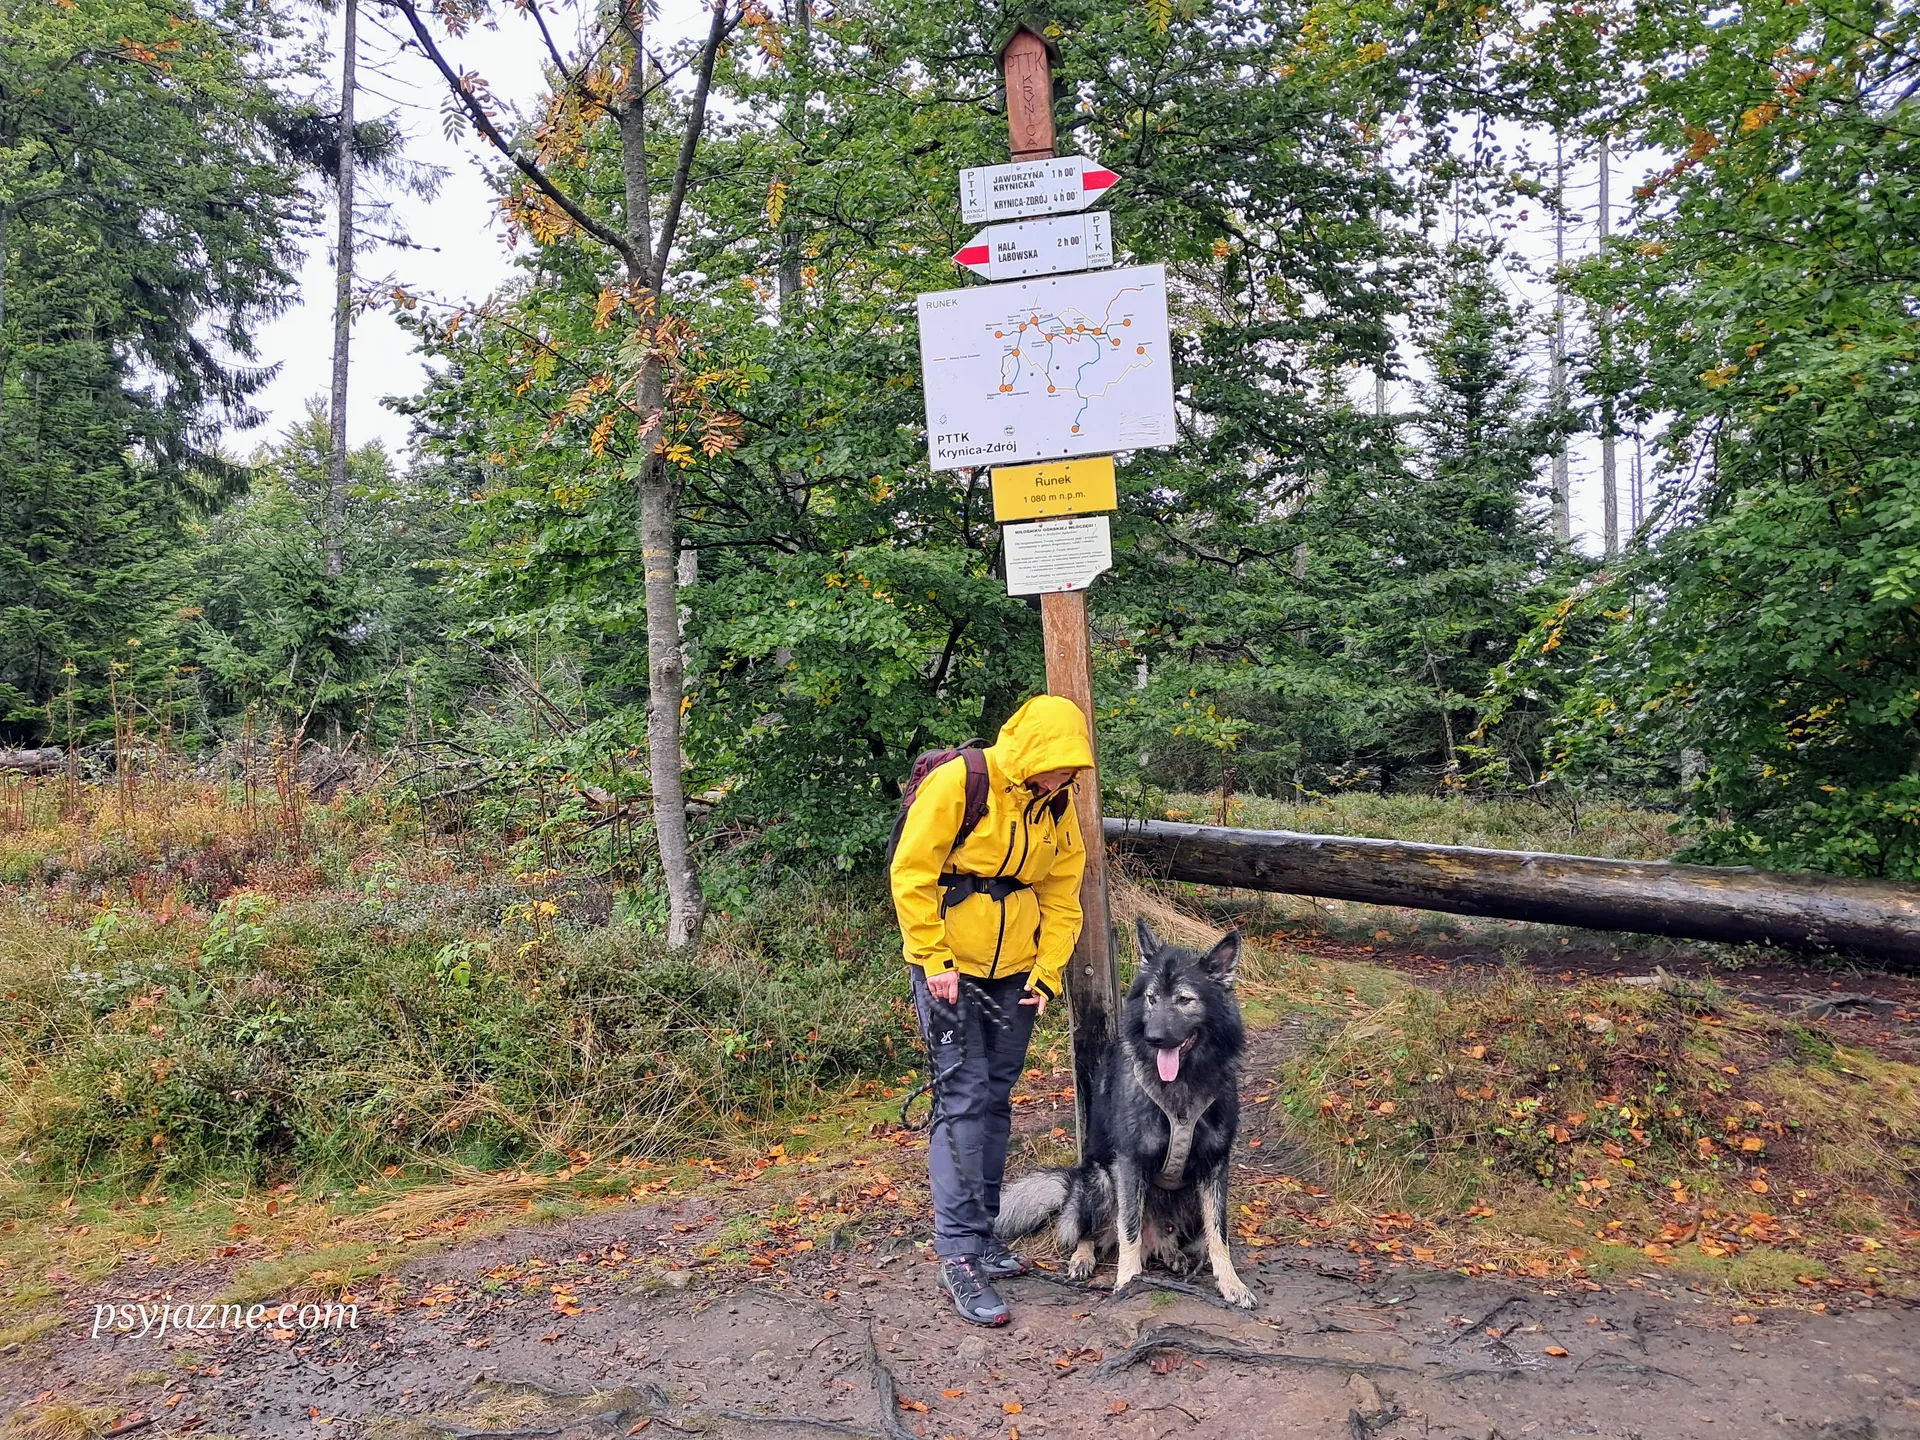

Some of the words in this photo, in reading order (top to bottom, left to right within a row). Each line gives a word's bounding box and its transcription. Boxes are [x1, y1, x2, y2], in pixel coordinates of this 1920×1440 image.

[1007, 51, 1045, 75] PTTK
[1022, 74, 1038, 147] KRYNICA
[993, 170, 1045, 184] JAWORZYNA
[1057, 169, 1063, 178] h
[967, 171, 978, 207] PTTK
[993, 180, 1036, 192] KRYNICKA
[994, 192, 1048, 210] KRYNICA-ZDRÓJ
[1053, 193, 1059, 203] 4
[1059, 192, 1065, 202] h
[1092, 215, 1104, 251] PTTK
[997, 241, 1016, 252] HALA
[1057, 238, 1063, 247] 2
[1063, 237, 1069, 246] h
[998, 249, 1039, 263] ŁABOWSKA
[926, 298, 958, 310] RUNEK
[937, 432, 970, 445] PTTK
[938, 441, 1017, 460] Krynica-Zdrój
[1035, 474, 1072, 487] Runek
[1030, 494, 1047, 503] 080
[1059, 491, 1086, 501] n.p.m.
